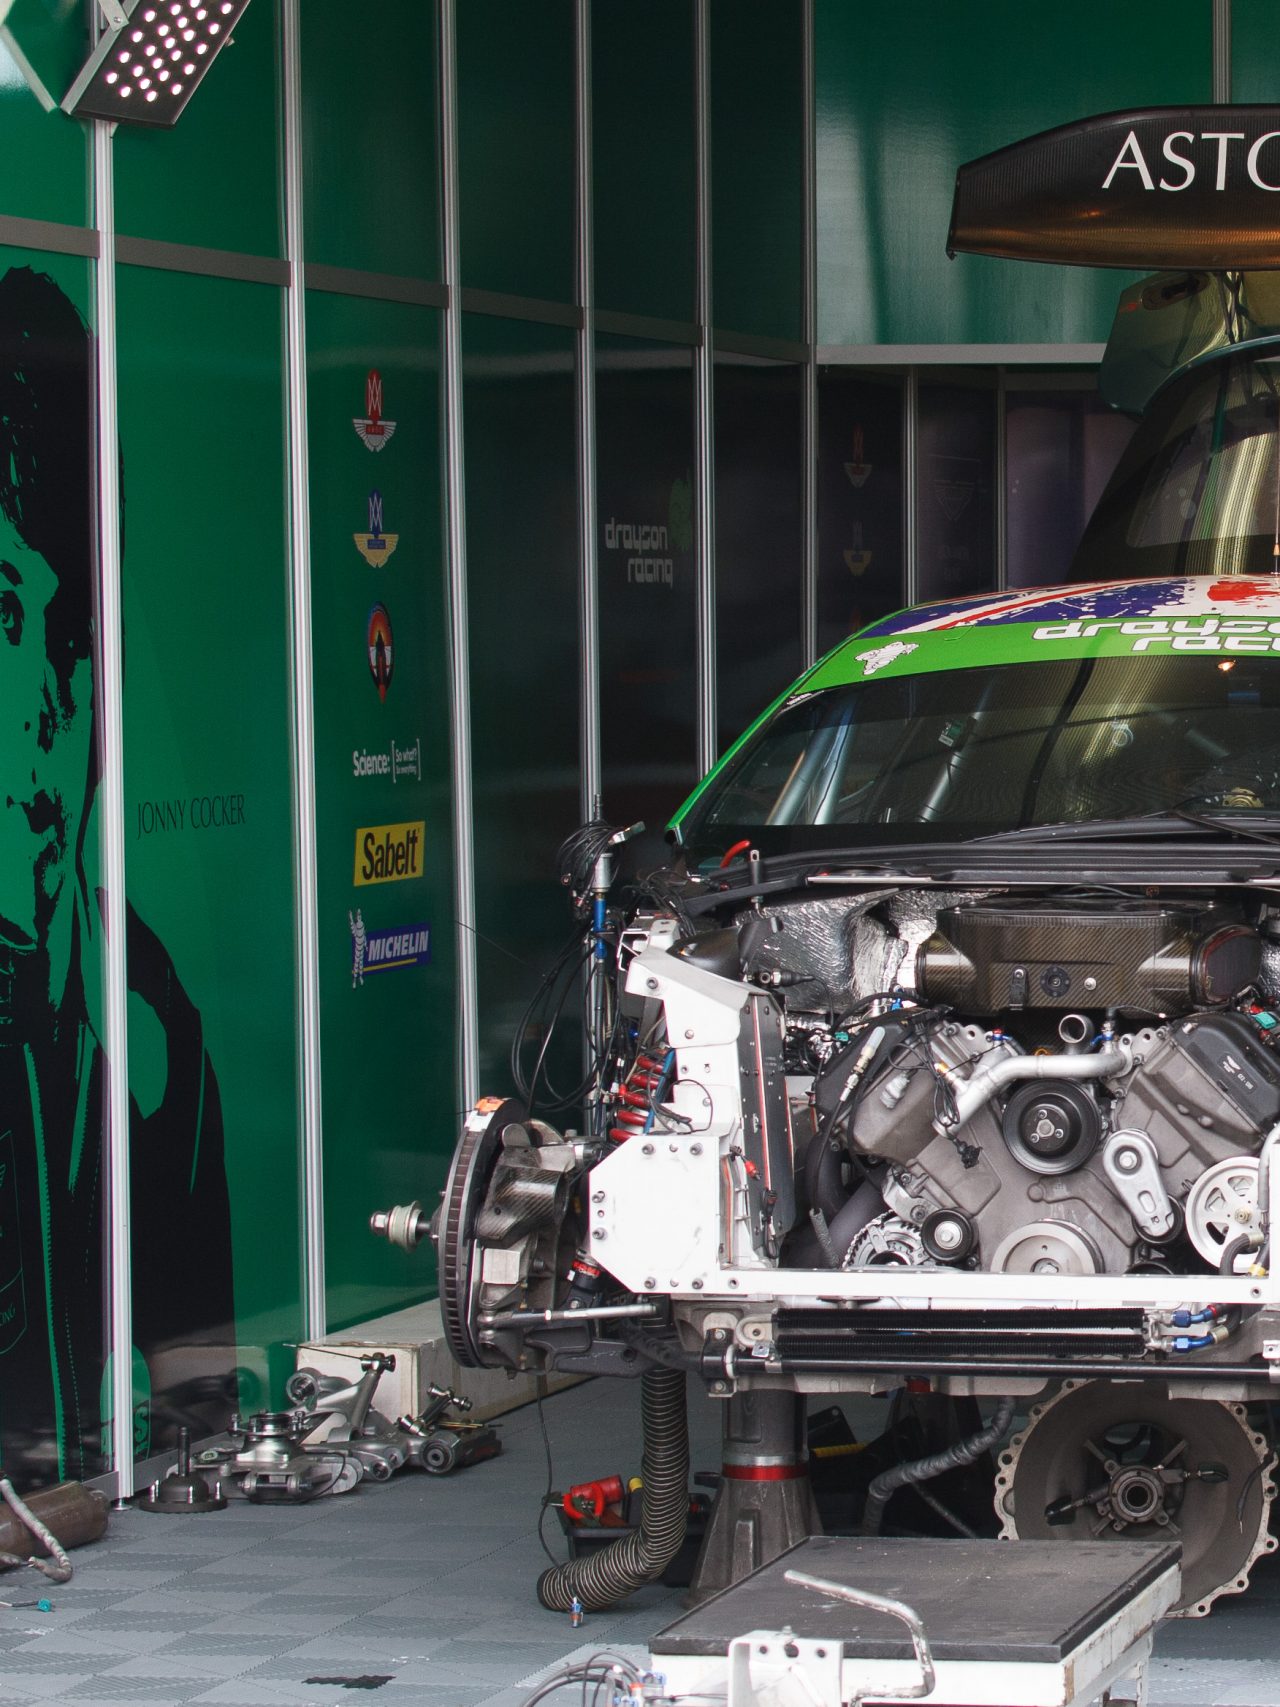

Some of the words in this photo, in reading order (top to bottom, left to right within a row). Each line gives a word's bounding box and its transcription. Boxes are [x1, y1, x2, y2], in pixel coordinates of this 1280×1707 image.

[605, 517, 668, 555] drayson
[628, 558, 673, 590] racing
[138, 800, 187, 840] JONNY
[190, 794, 246, 829] COCKER
[362, 829, 418, 880] Sabelt
[368, 930, 429, 962] MICHELIN
